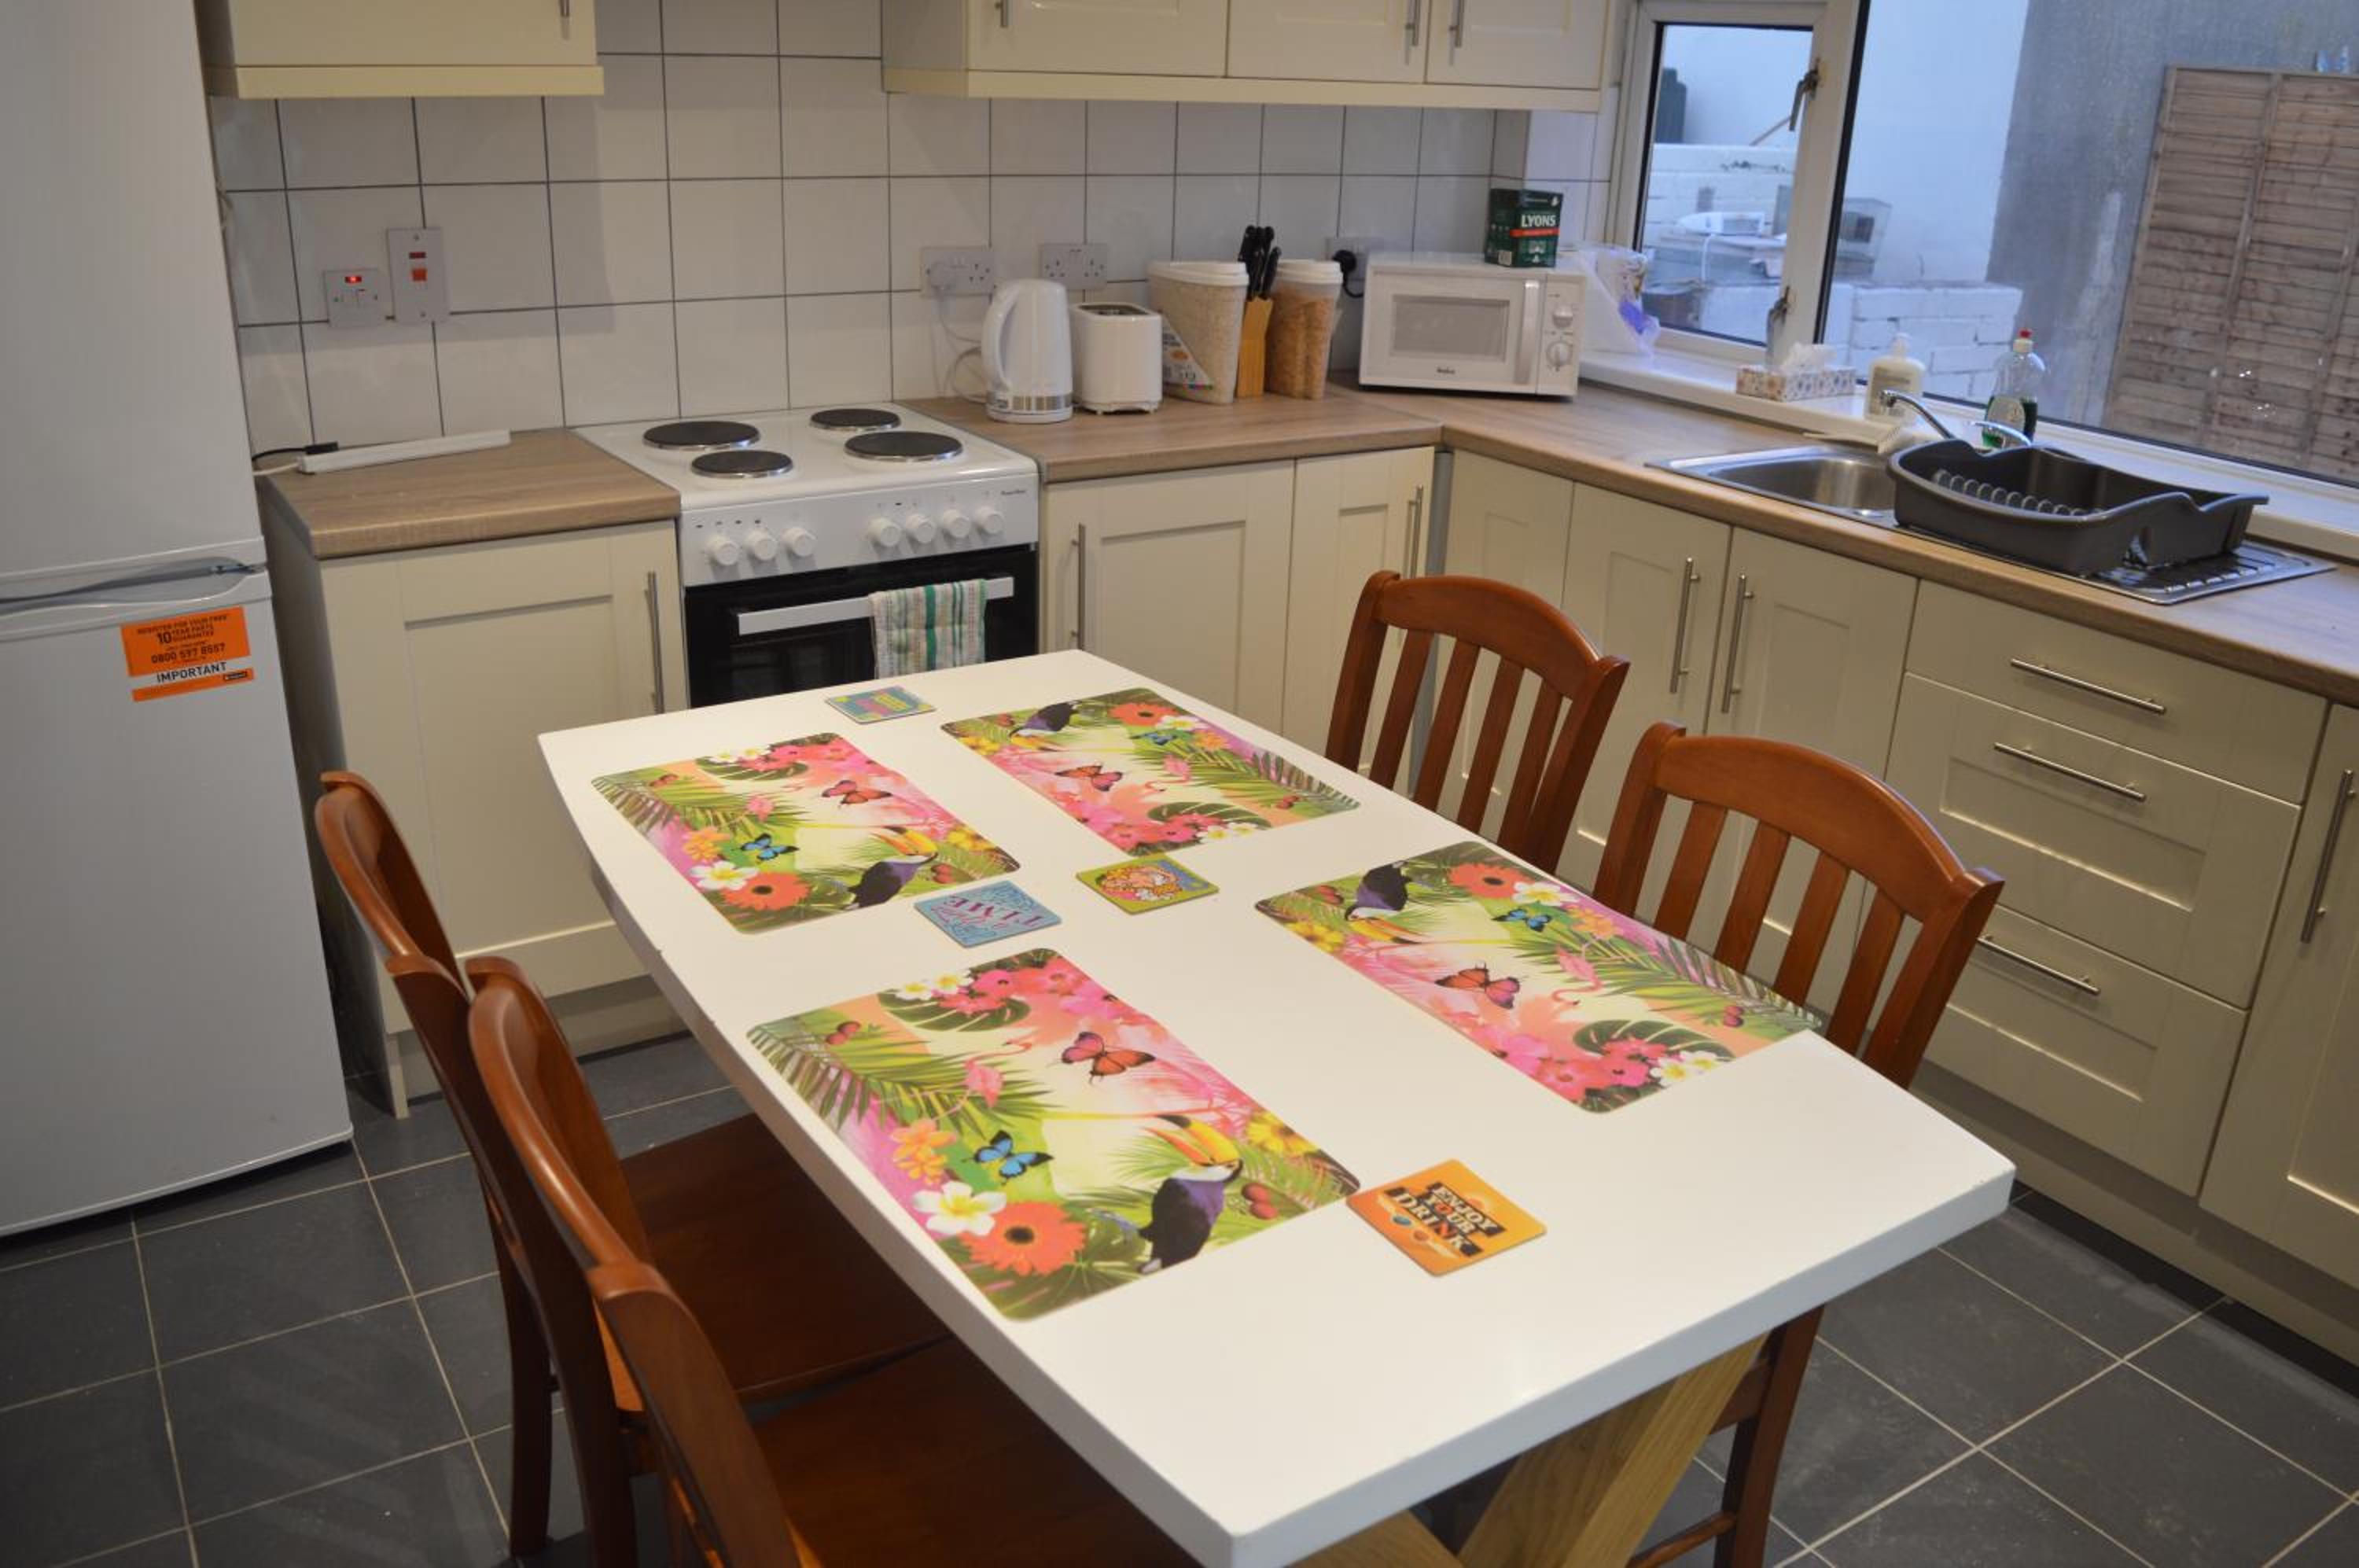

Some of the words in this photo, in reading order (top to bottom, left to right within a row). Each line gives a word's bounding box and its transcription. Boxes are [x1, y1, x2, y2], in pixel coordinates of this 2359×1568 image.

[1521, 214, 1556, 227] LYONS
[157, 631, 171, 643] 10
[157, 661, 226, 683] IMPORTANT
[1433, 1186, 1498, 1229] ENJOY
